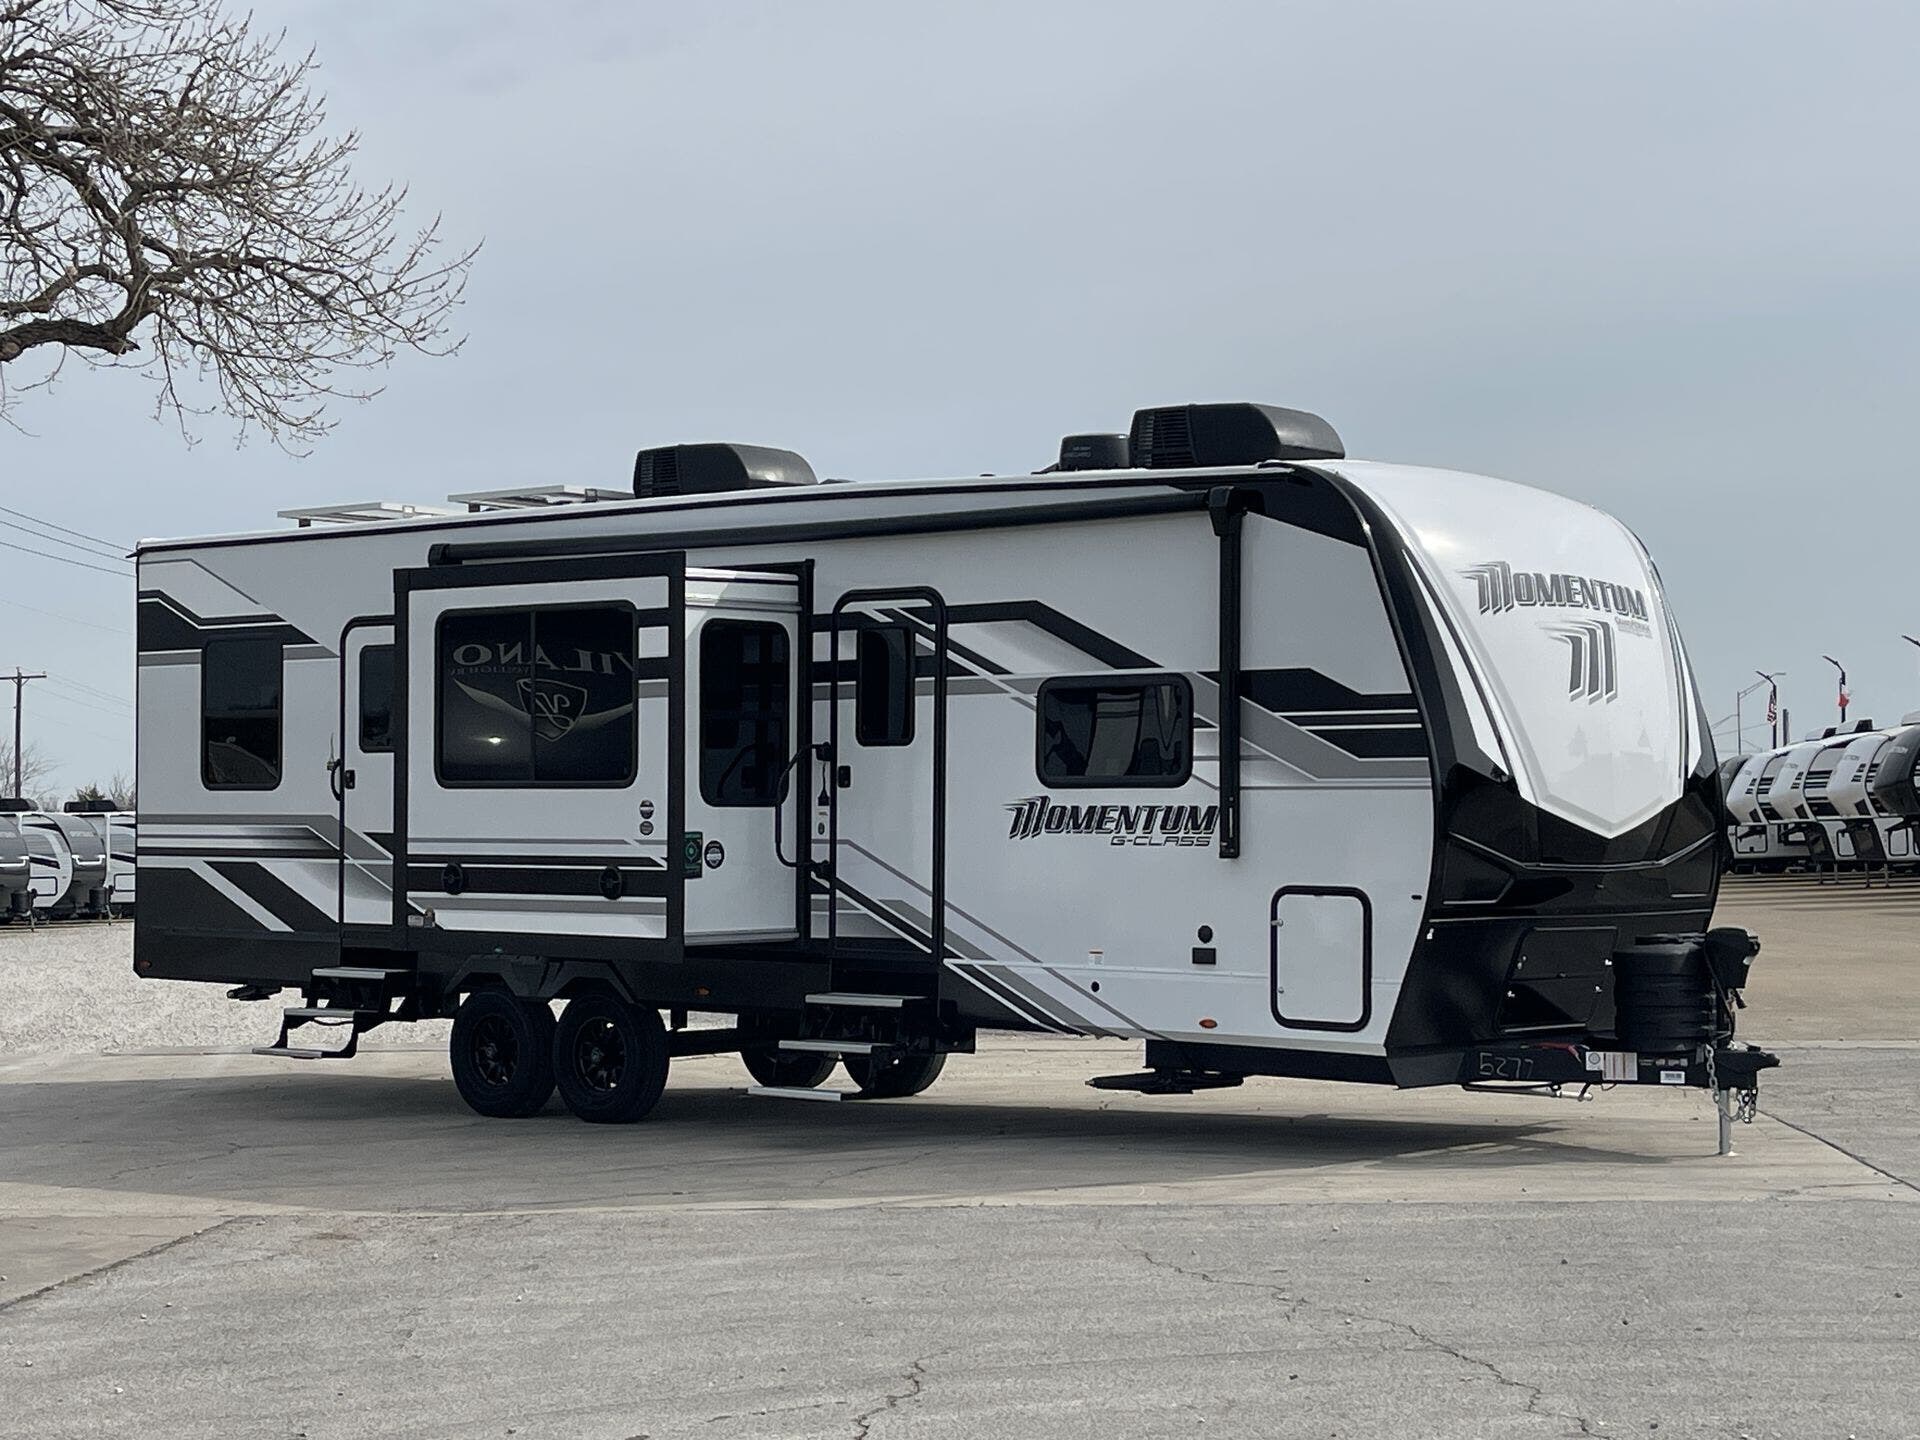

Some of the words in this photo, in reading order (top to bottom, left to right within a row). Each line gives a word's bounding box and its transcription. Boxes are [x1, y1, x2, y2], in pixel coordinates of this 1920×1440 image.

[1456, 561, 1650, 621] MOMENTUM
[1002, 796, 1221, 840] MOMENTUM
[1110, 836, 1212, 847] G-CLASS
[1479, 1052, 1534, 1080] 5277
